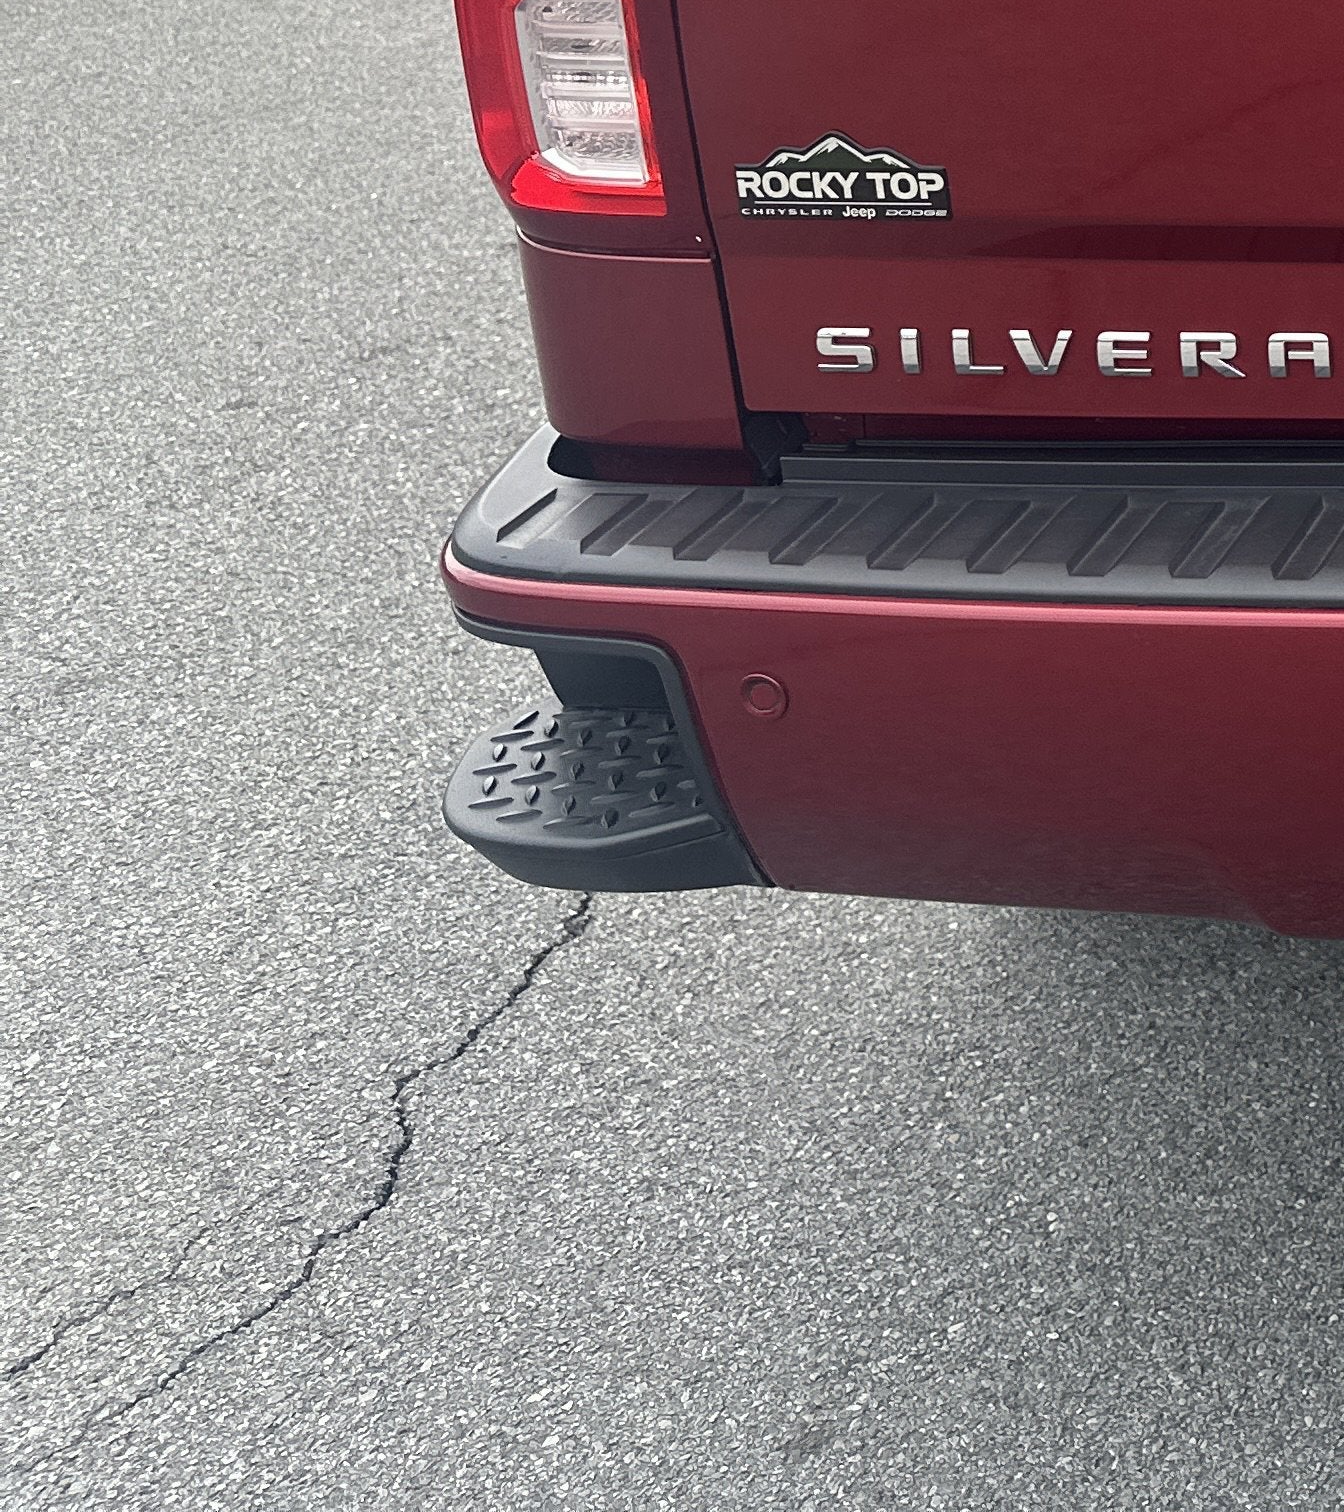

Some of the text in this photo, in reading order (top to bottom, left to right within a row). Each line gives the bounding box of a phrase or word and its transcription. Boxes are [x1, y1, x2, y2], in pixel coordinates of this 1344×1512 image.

[735, 170, 945, 200] ROCKY TOP
[741, 205, 948, 220] CHRYSLER Jeep DODGE
